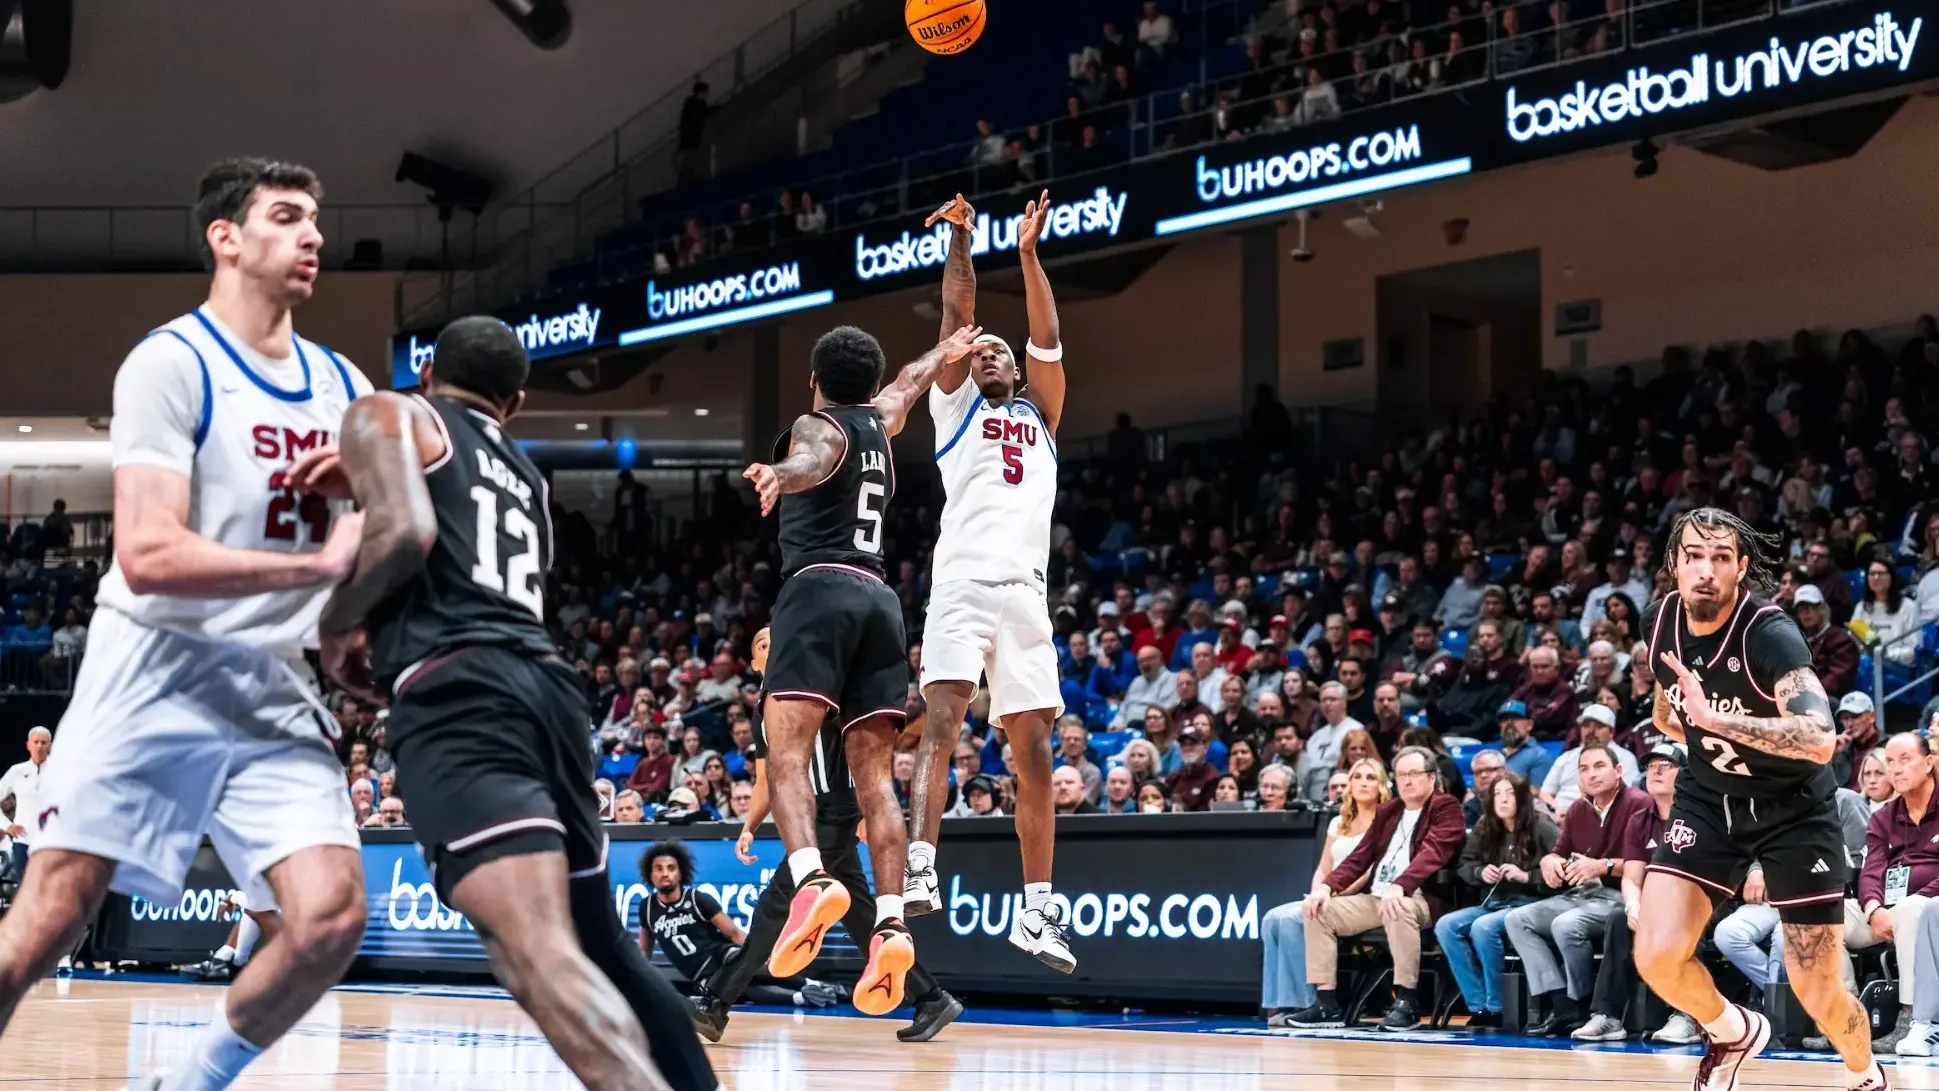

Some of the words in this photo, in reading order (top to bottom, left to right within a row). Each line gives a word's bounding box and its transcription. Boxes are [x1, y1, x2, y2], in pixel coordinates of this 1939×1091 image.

[917, 14, 970, 40] Wilson
[936, 37, 972, 53] NCAA
[1506, 53, 1710, 143] basketball
[1714, 11, 1923, 98] university
[982, 417, 1038, 447] SMU
[1001, 443, 1025, 486] 5
[853, 480, 885, 554] 5
[470, 485, 544, 622] 12
[1701, 736, 1753, 776] 2
[653, 913, 697, 938] Aggies
